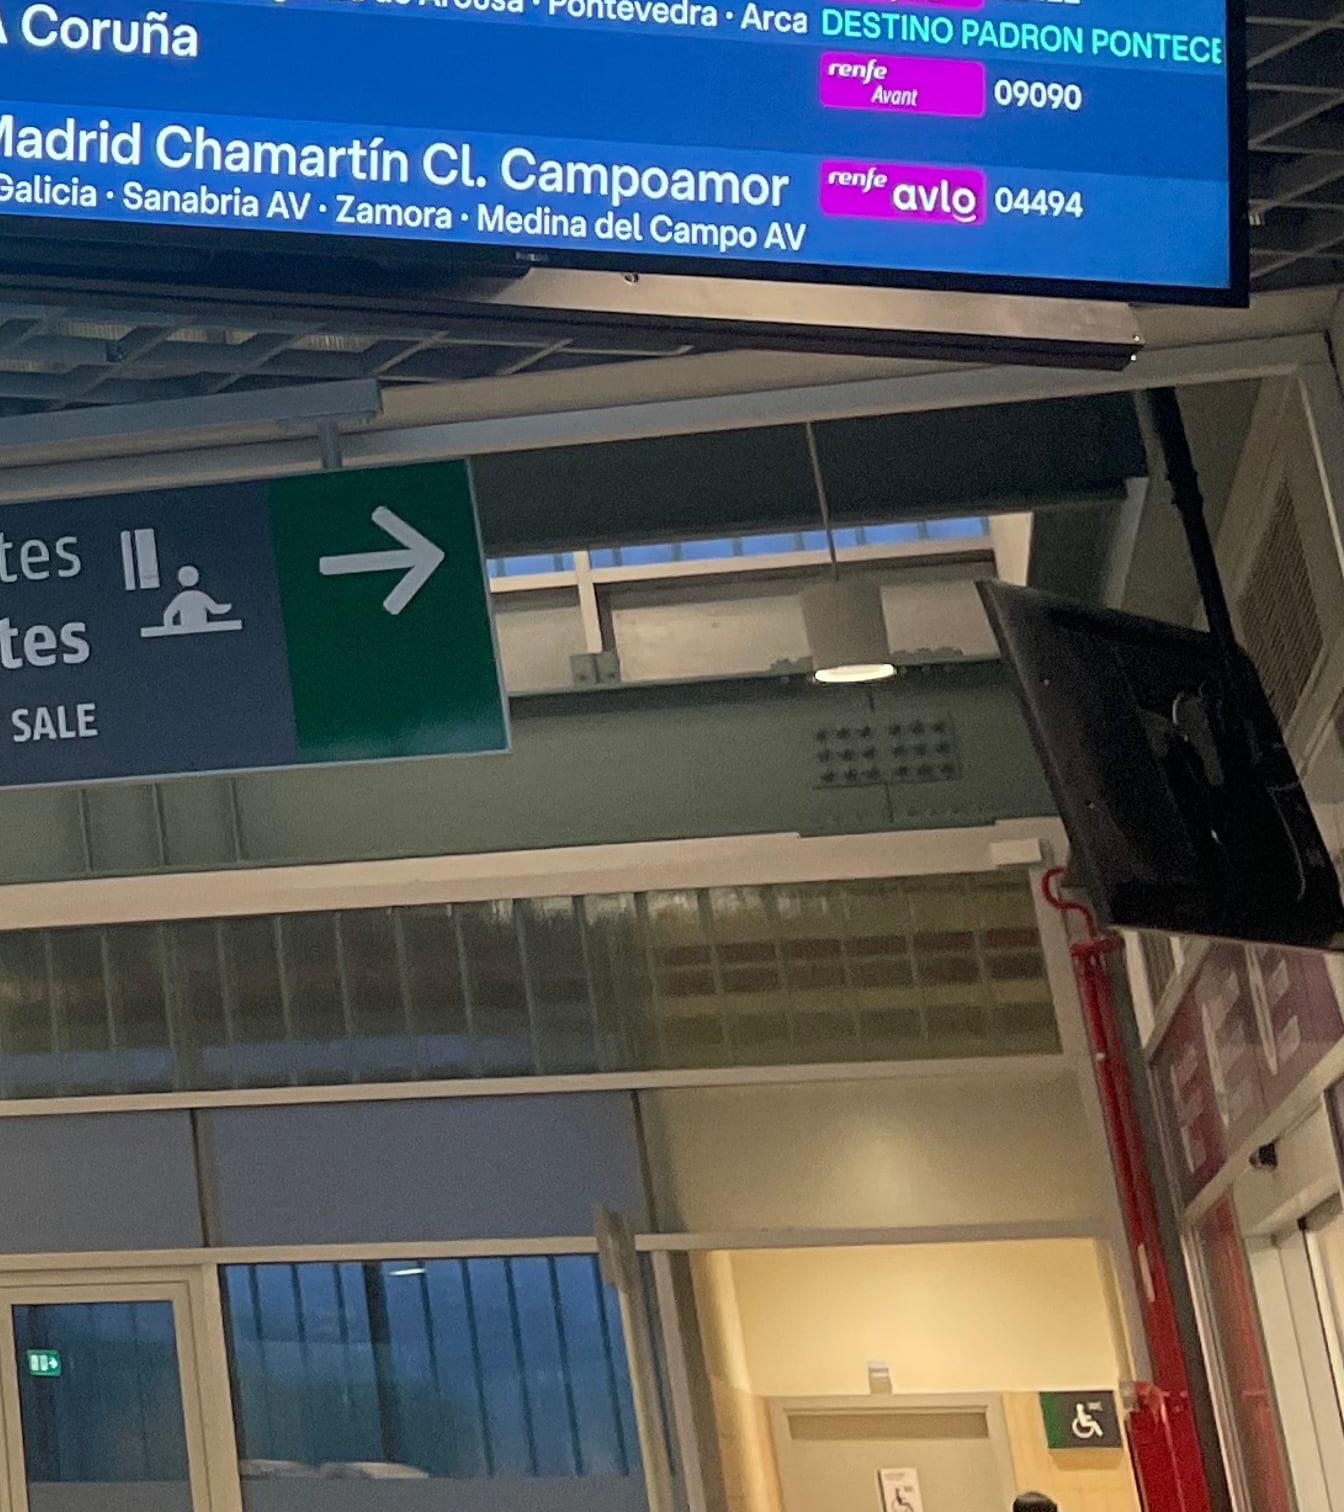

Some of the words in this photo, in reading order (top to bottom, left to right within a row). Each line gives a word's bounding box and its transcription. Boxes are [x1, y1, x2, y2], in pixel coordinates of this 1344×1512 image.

[21, 3, 198, 57] Coruña
[740, 2, 808, 34] Arca
[822, 8, 954, 44] DESTINO
[961, 18, 1084, 54] PADRON
[994, 79, 1082, 111] 09090
[155, 125, 408, 183] Chamartín
[422, 142, 487, 188] Cl.
[501, 147, 790, 207] Campoamor
[122, 181, 259, 217] Sanabria
[266, 190, 311, 220] AV
[335, 194, 452, 229] Zamora
[477, 203, 587, 238] Medina
[594, 210, 643, 241] del
[649, 214, 757, 253] Campo
[763, 221, 806, 251] AV
[994, 186, 1084, 218] 04494
[11, 703, 98, 743] SALE
